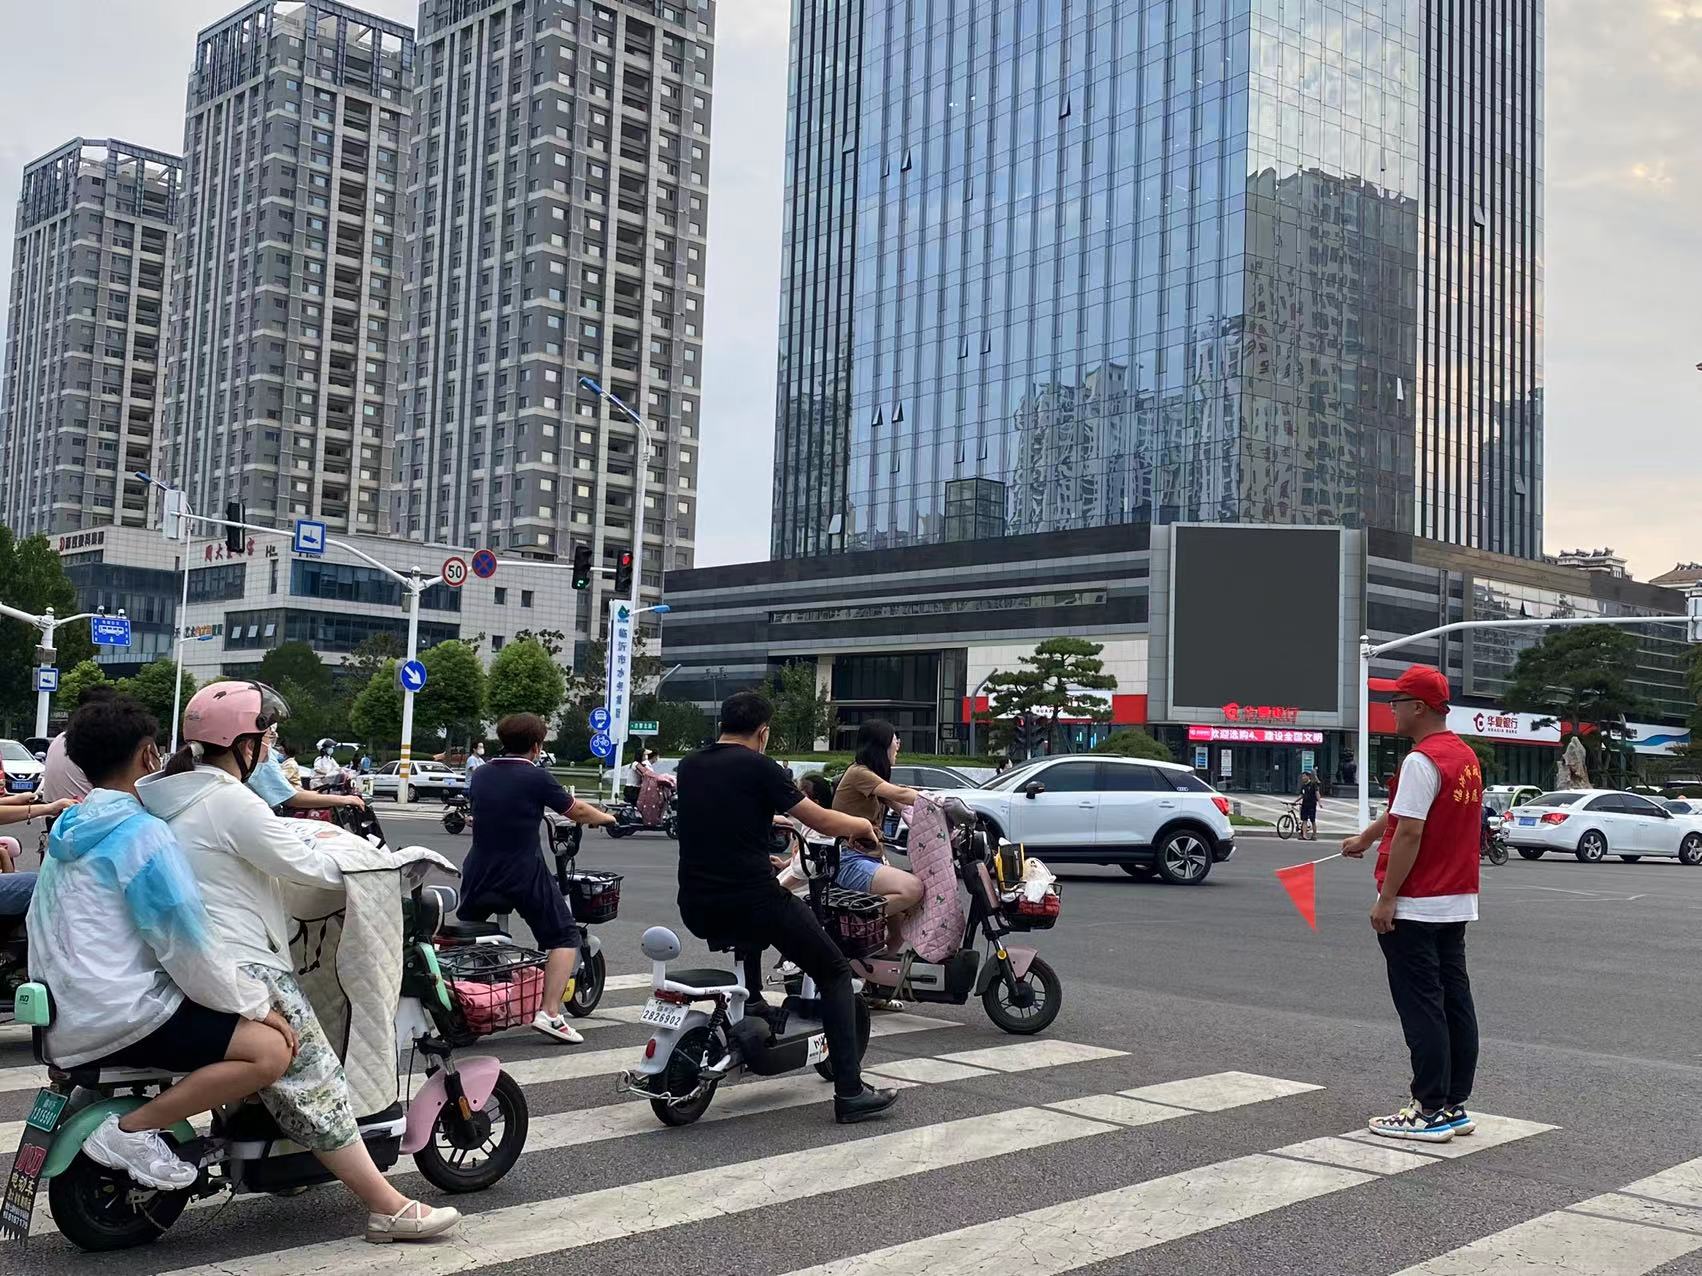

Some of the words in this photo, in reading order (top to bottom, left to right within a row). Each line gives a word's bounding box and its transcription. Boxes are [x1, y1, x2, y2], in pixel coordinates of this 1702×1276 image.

[448, 565, 462, 579] 50
[1487, 715, 1518, 729] 华夏银行
[642, 1009, 682, 1026] 2826902
[12, 1172, 35, 1196] 电动车
